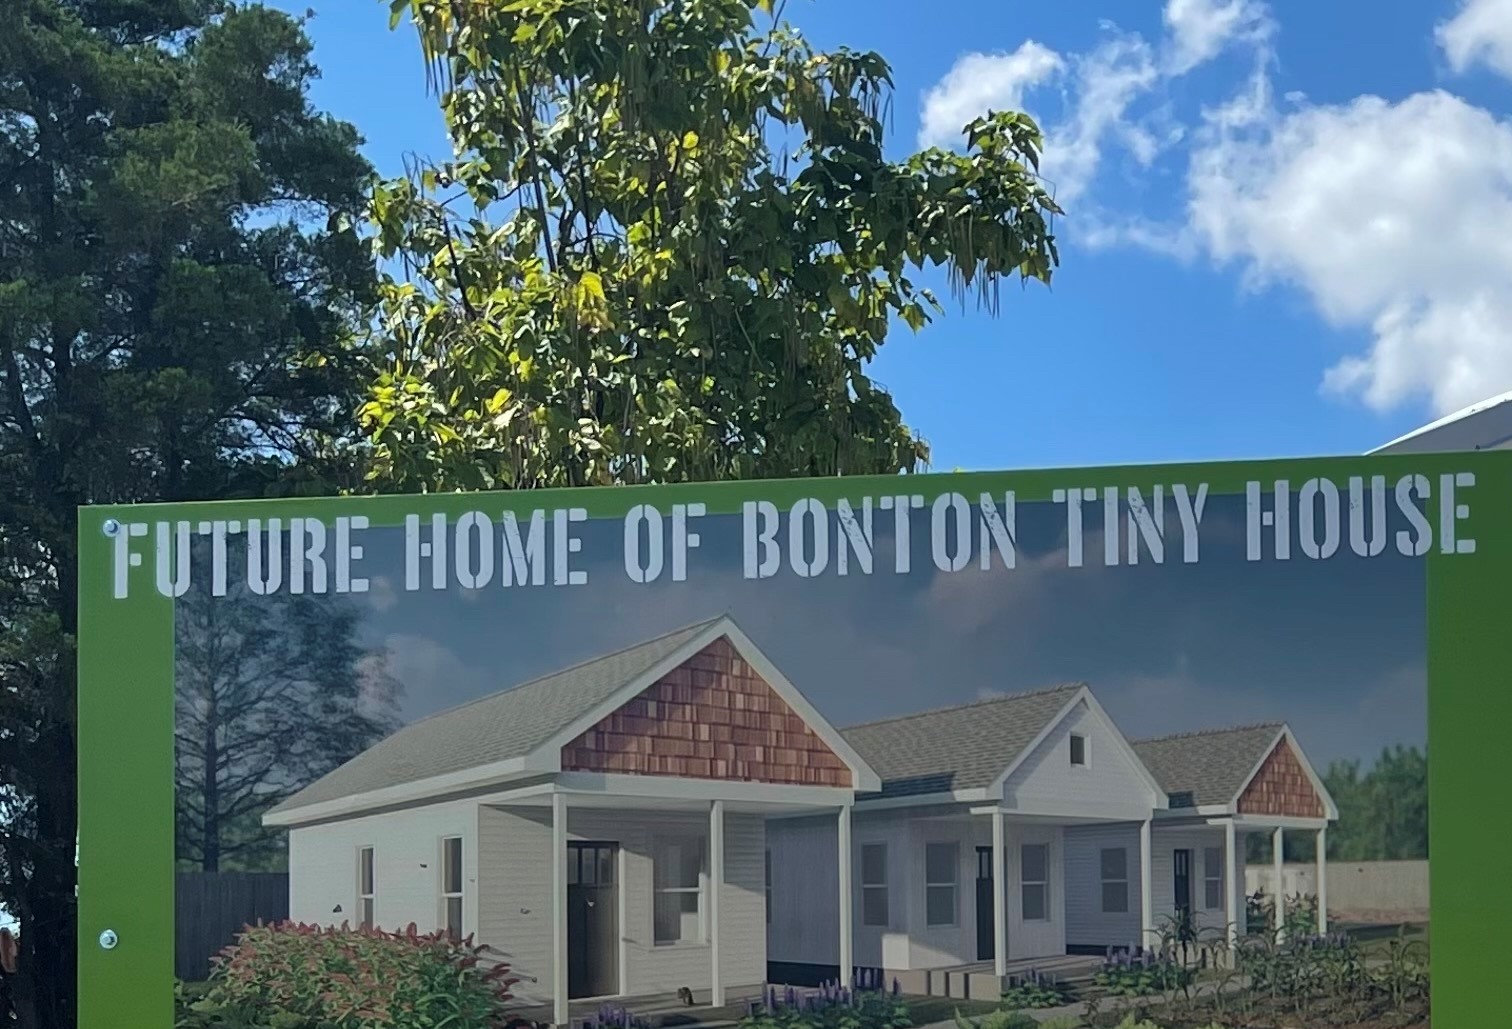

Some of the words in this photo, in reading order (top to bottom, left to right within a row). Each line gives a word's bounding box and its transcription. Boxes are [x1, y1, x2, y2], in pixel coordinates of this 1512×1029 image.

[114, 516, 370, 599] FUTURE
[405, 507, 588, 591] HOME
[624, 503, 706, 583] OF
[742, 490, 1016, 579] BONTON
[1052, 483, 1209, 567] TINY
[1246, 472, 1476, 561] HOUSE
